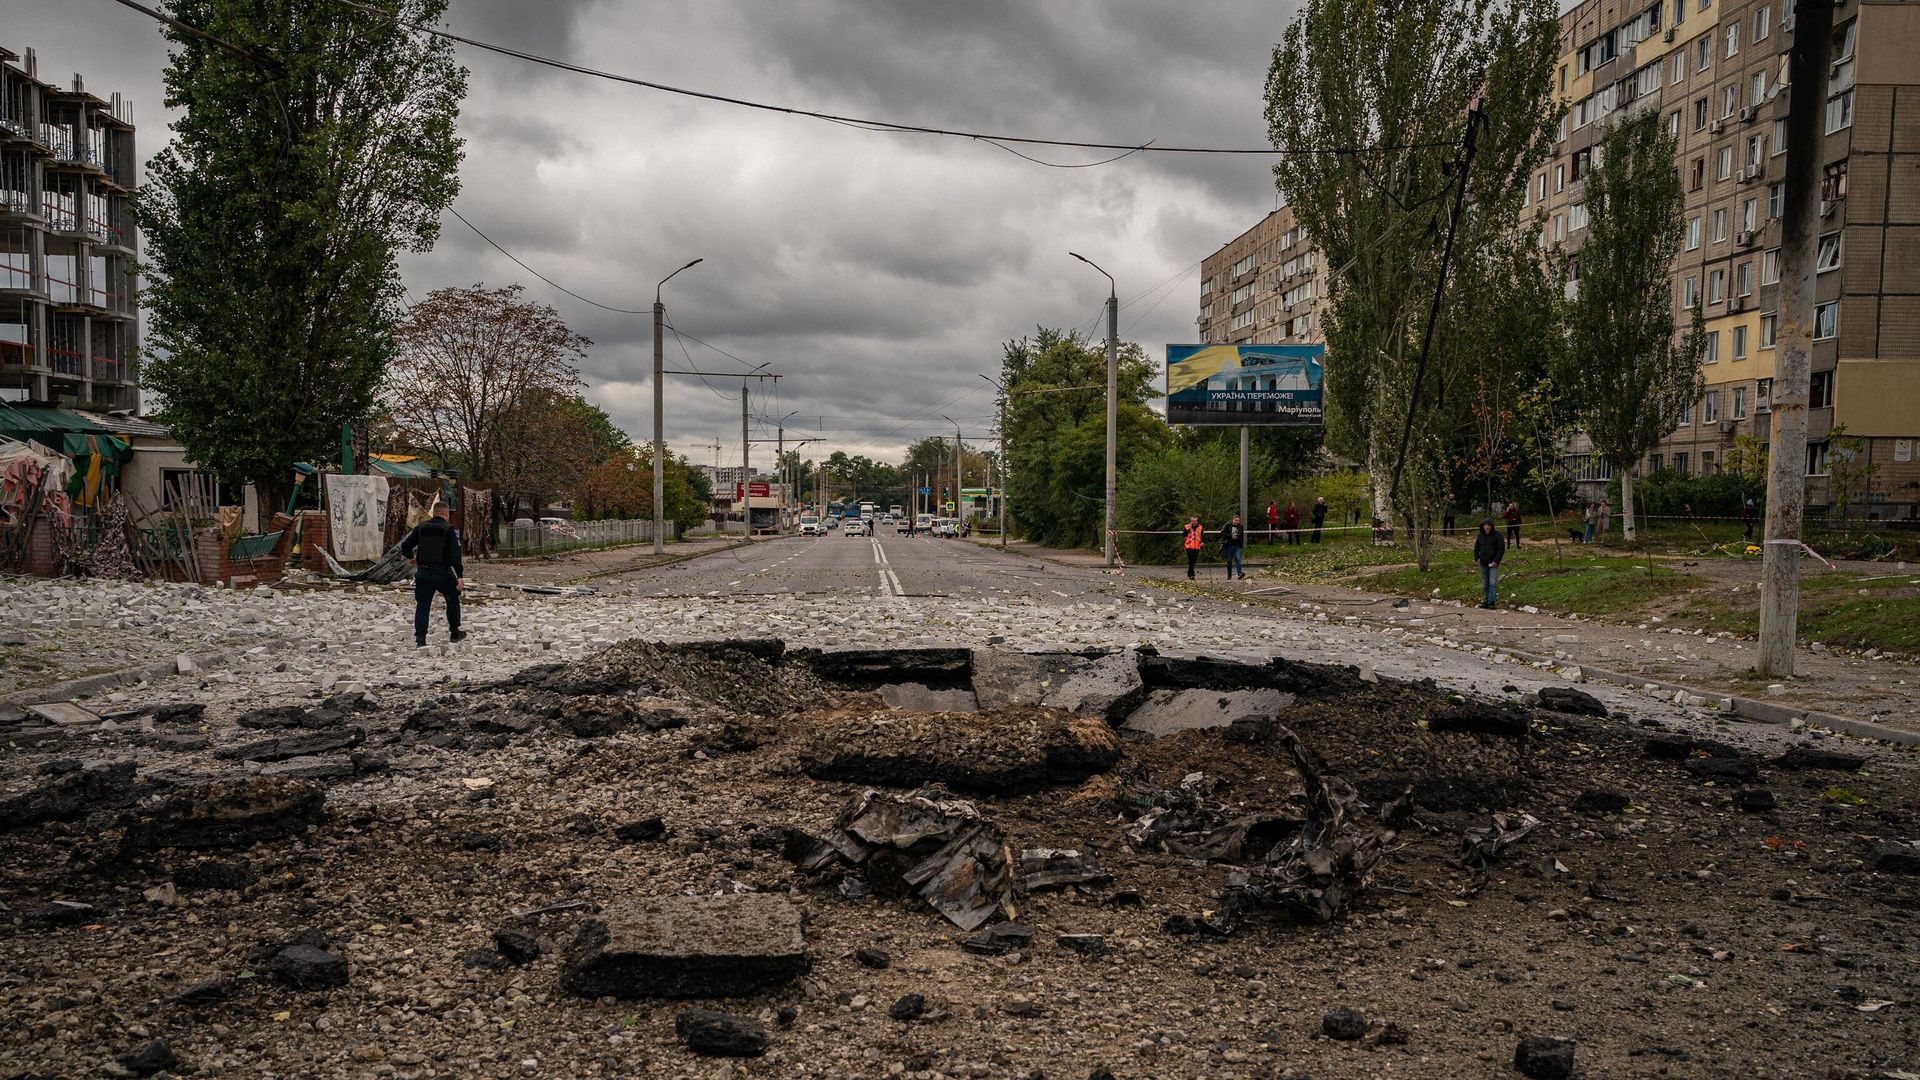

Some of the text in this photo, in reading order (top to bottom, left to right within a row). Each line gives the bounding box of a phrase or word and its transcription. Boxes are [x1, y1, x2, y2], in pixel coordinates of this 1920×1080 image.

[1211, 391, 1294, 400] УКРАЇНА ПЕРЕМОЖЕ!
[1278, 405, 1322, 415] Маріуполь
